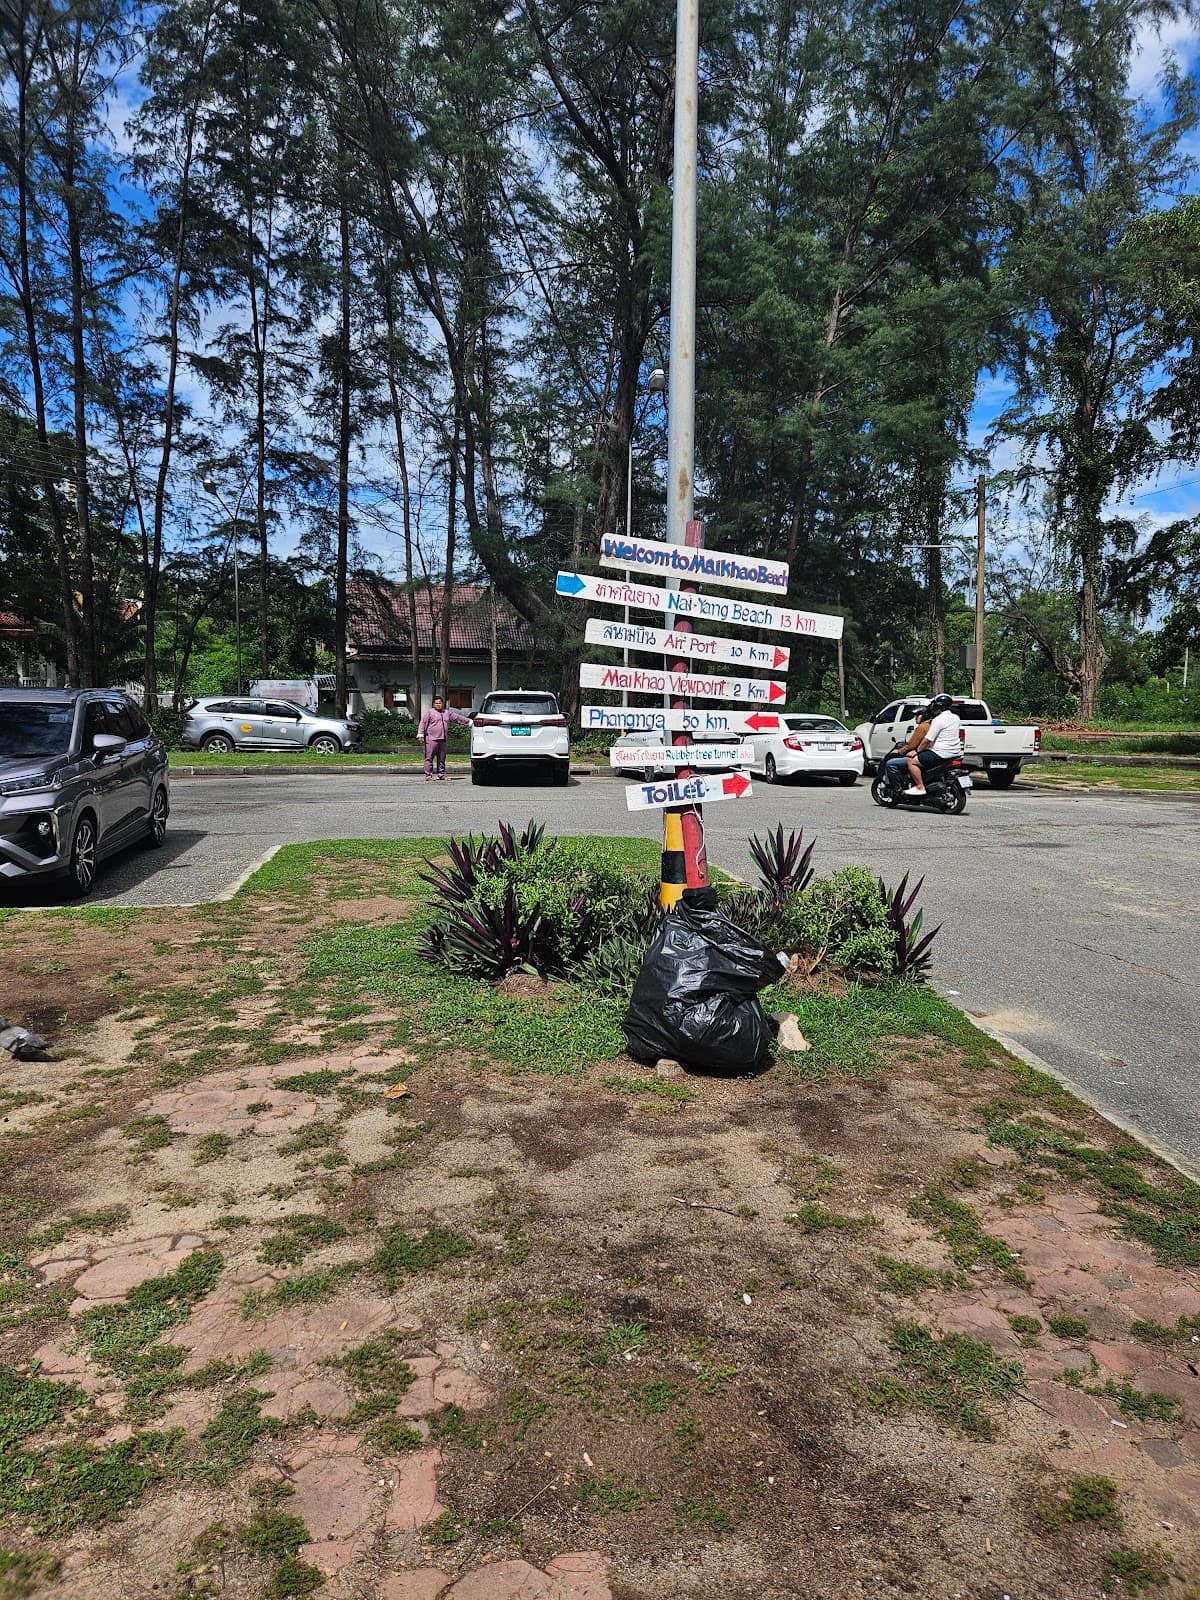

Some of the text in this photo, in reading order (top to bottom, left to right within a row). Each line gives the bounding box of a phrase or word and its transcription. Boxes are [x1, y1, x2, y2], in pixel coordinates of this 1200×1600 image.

[732, 603, 773, 625] Beach
[781, 614, 792, 628] 13
[690, 637, 718, 654] Port
[730, 645, 743, 657] 10
[733, 683, 742, 697] 2
[589, 708, 665, 729] Phangnga
[682, 715, 699, 729] 50
[665, 748, 694, 761] Rubber
